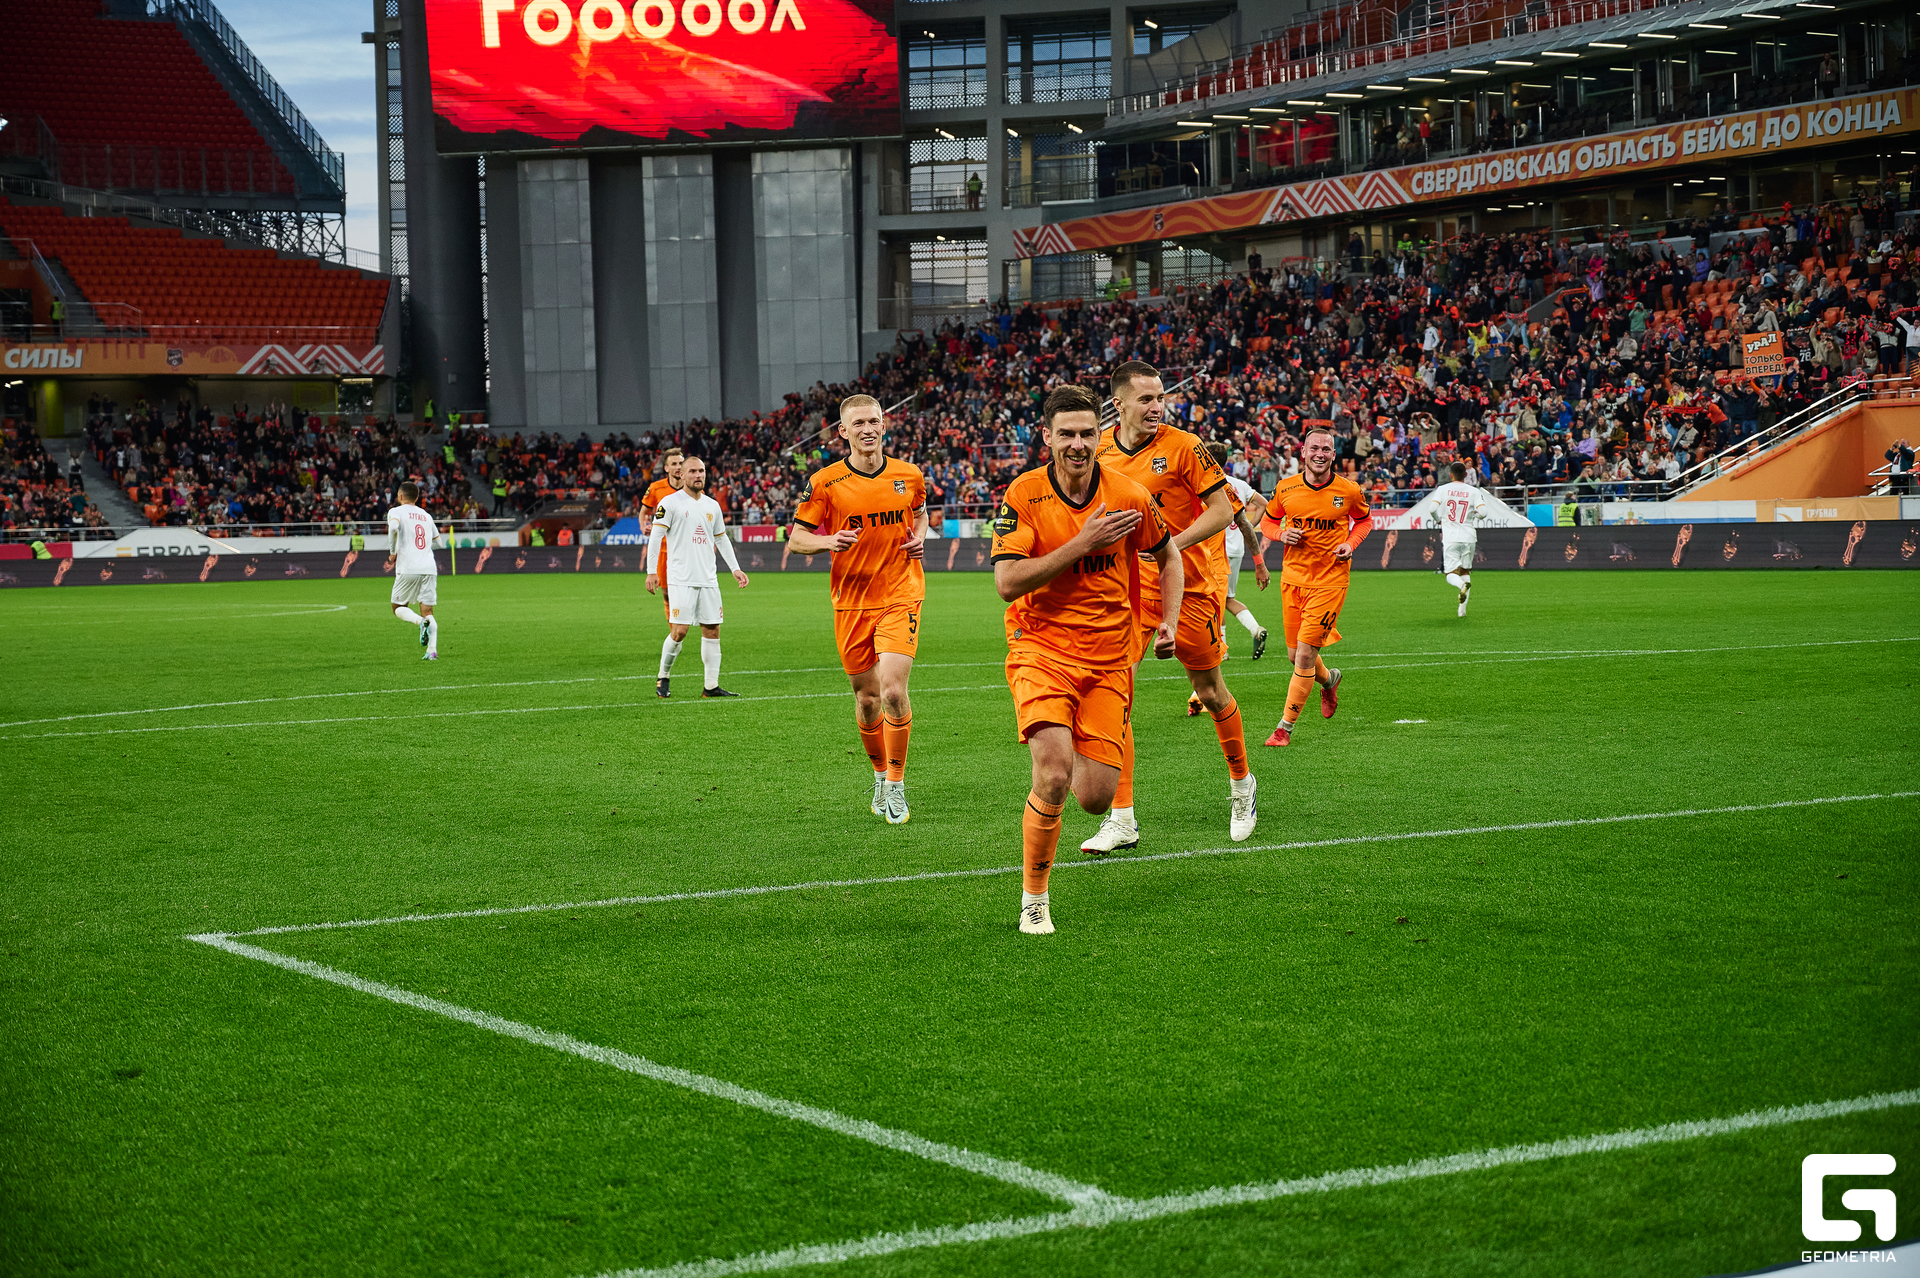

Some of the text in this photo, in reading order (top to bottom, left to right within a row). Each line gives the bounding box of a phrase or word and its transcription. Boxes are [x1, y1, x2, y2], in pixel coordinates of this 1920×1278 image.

[1411, 99, 1902, 195] СВЕРДЛОВСКАЯ ОБЛАСТЬ БЕЙСЯ ДО КОНЦА
[4, 348, 83, 369] СИЛЫ
[1744, 353, 1783, 365] ТОЛЬКО
[1094, 444, 1114, 460] ЕТСИТИ
[1446, 499, 1469, 524] 37
[1806, 508, 1838, 519] ТРУБНАЯ
[414, 523, 426, 551] 8
[908, 612, 917, 634] 5
[1320, 610, 1337, 630] 42
